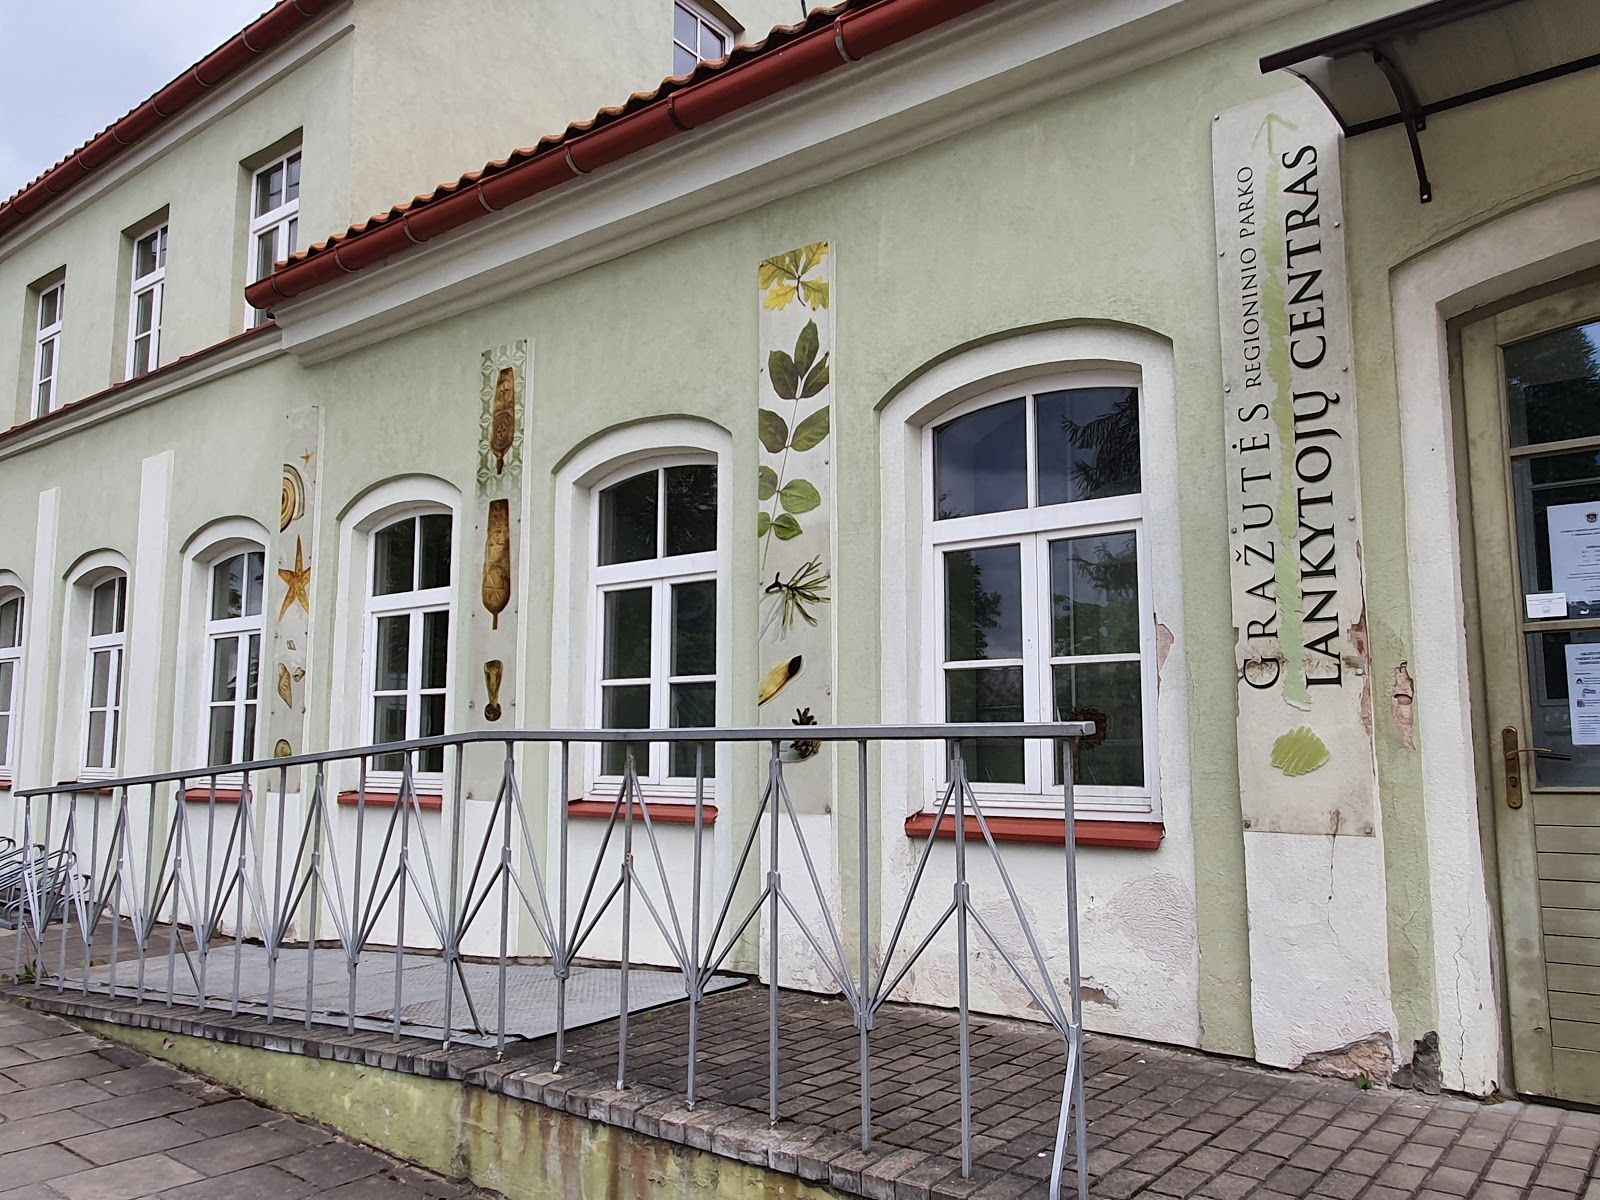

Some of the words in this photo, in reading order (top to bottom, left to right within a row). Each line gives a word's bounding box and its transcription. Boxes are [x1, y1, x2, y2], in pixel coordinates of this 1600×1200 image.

[1237, 166, 1256, 239] PARKO
[1281, 145, 1327, 370] CENTRAS
[1240, 247, 1262, 390] REGIONINIO
[1231, 403, 1281, 690] GRAŽUTĖS
[1292, 390, 1343, 689] LANKYTOJŲ
